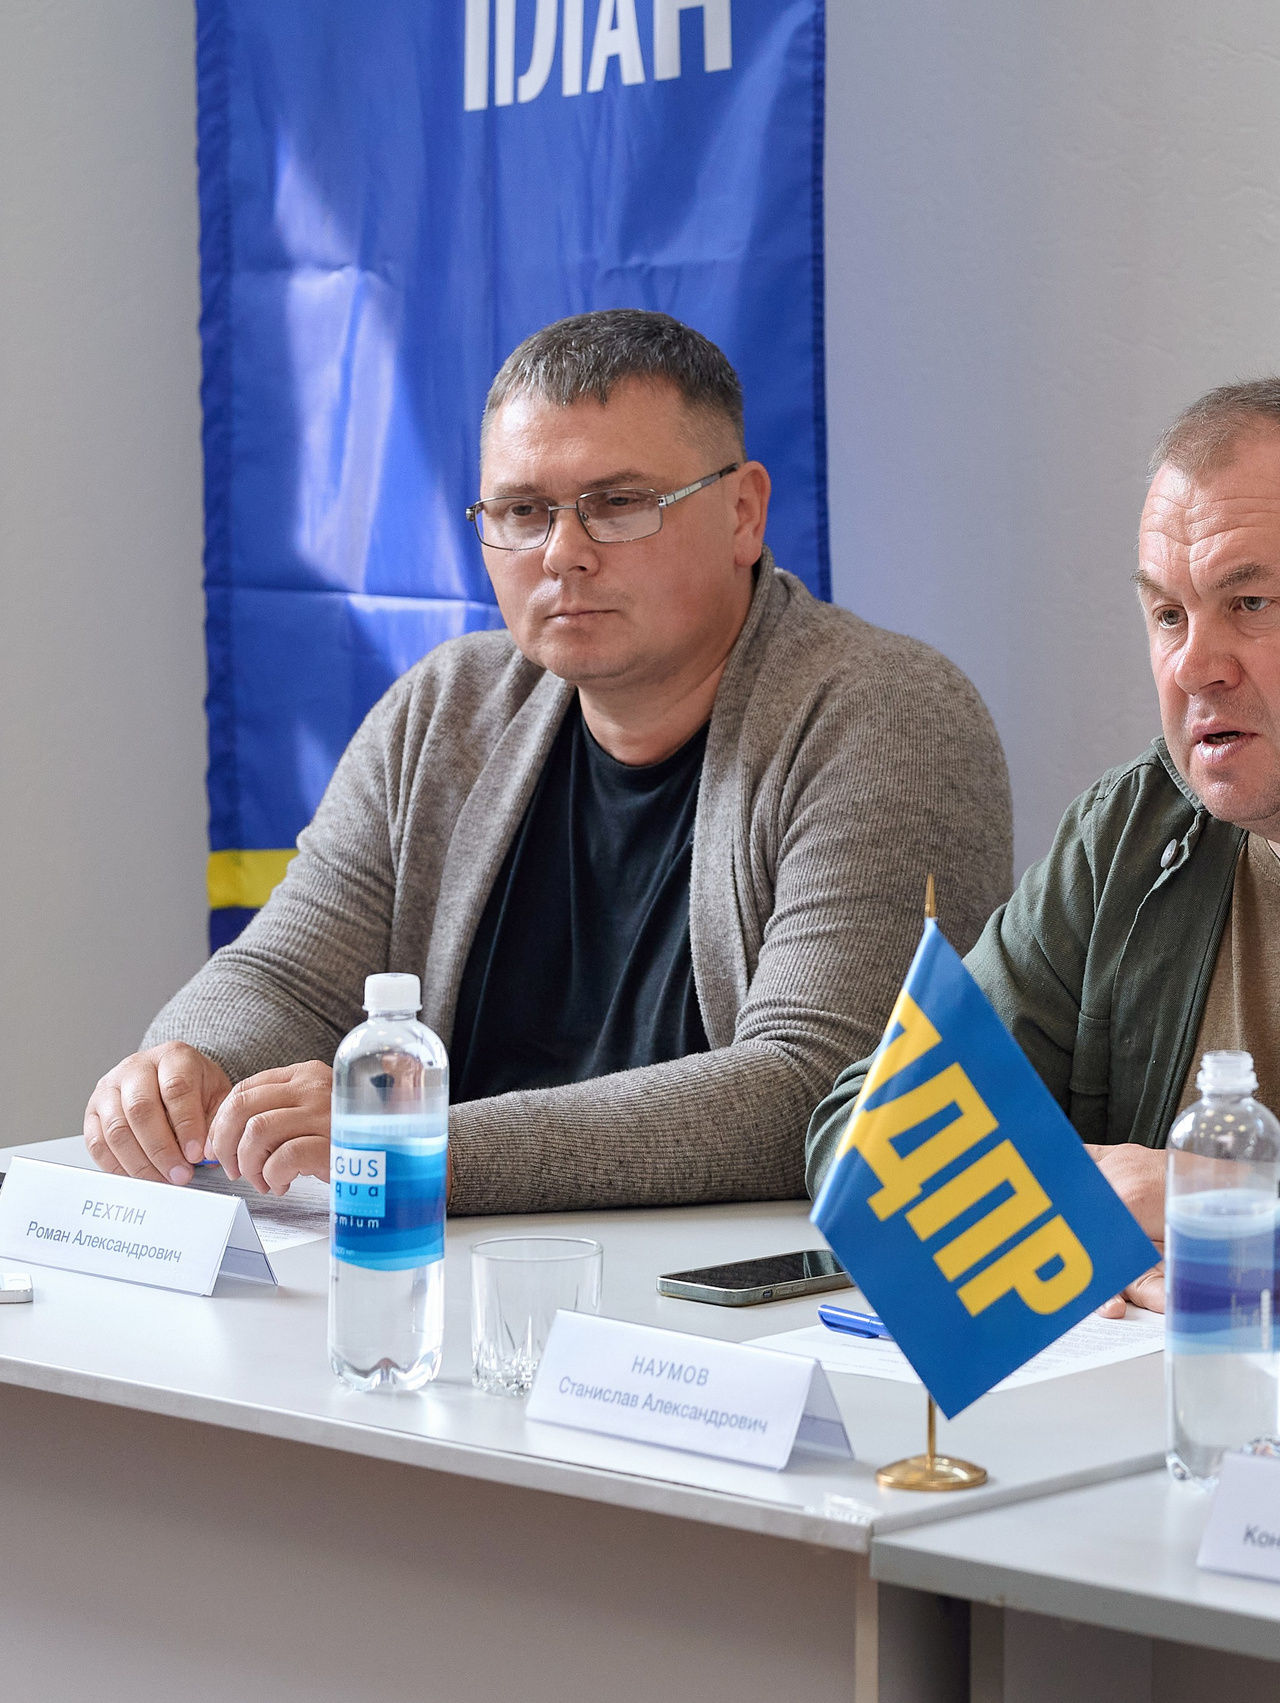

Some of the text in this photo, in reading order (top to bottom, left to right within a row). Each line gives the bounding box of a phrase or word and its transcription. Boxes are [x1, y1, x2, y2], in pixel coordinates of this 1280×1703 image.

[333, 1155, 379, 1178] GUS
[334, 1181, 379, 1198] qua
[81, 1199, 147, 1227] РЕХТИН
[334, 1214, 380, 1229] emium
[26, 1220, 182, 1263] Роман Александрович
[631, 1355, 709, 1386] НАУМОВ
[559, 1376, 769, 1434] Станислав Александрович
